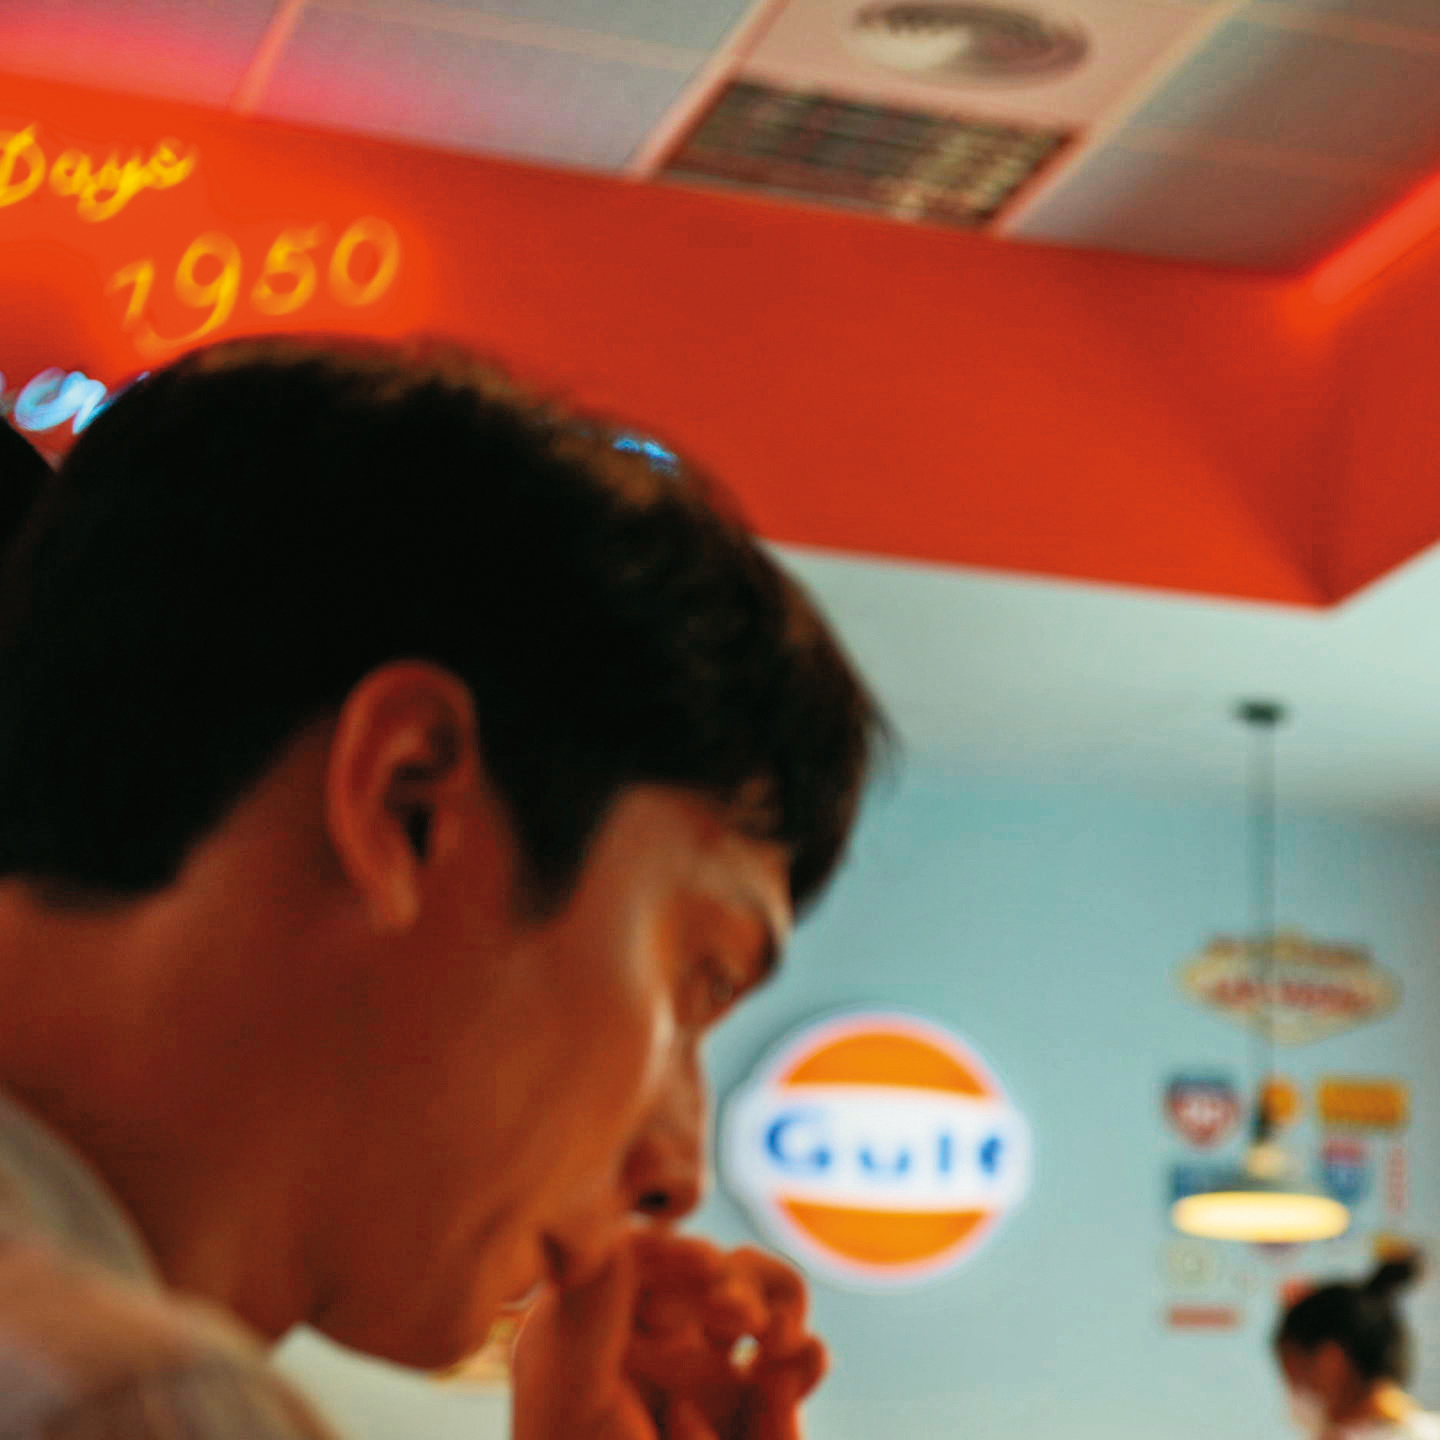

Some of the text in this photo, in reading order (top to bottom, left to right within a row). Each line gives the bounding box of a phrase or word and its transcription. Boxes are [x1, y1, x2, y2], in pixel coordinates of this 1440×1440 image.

[0, 123, 195, 222] Days
[104, 215, 399, 354] 1950
[763, 1107, 1008, 1178] Gulf
